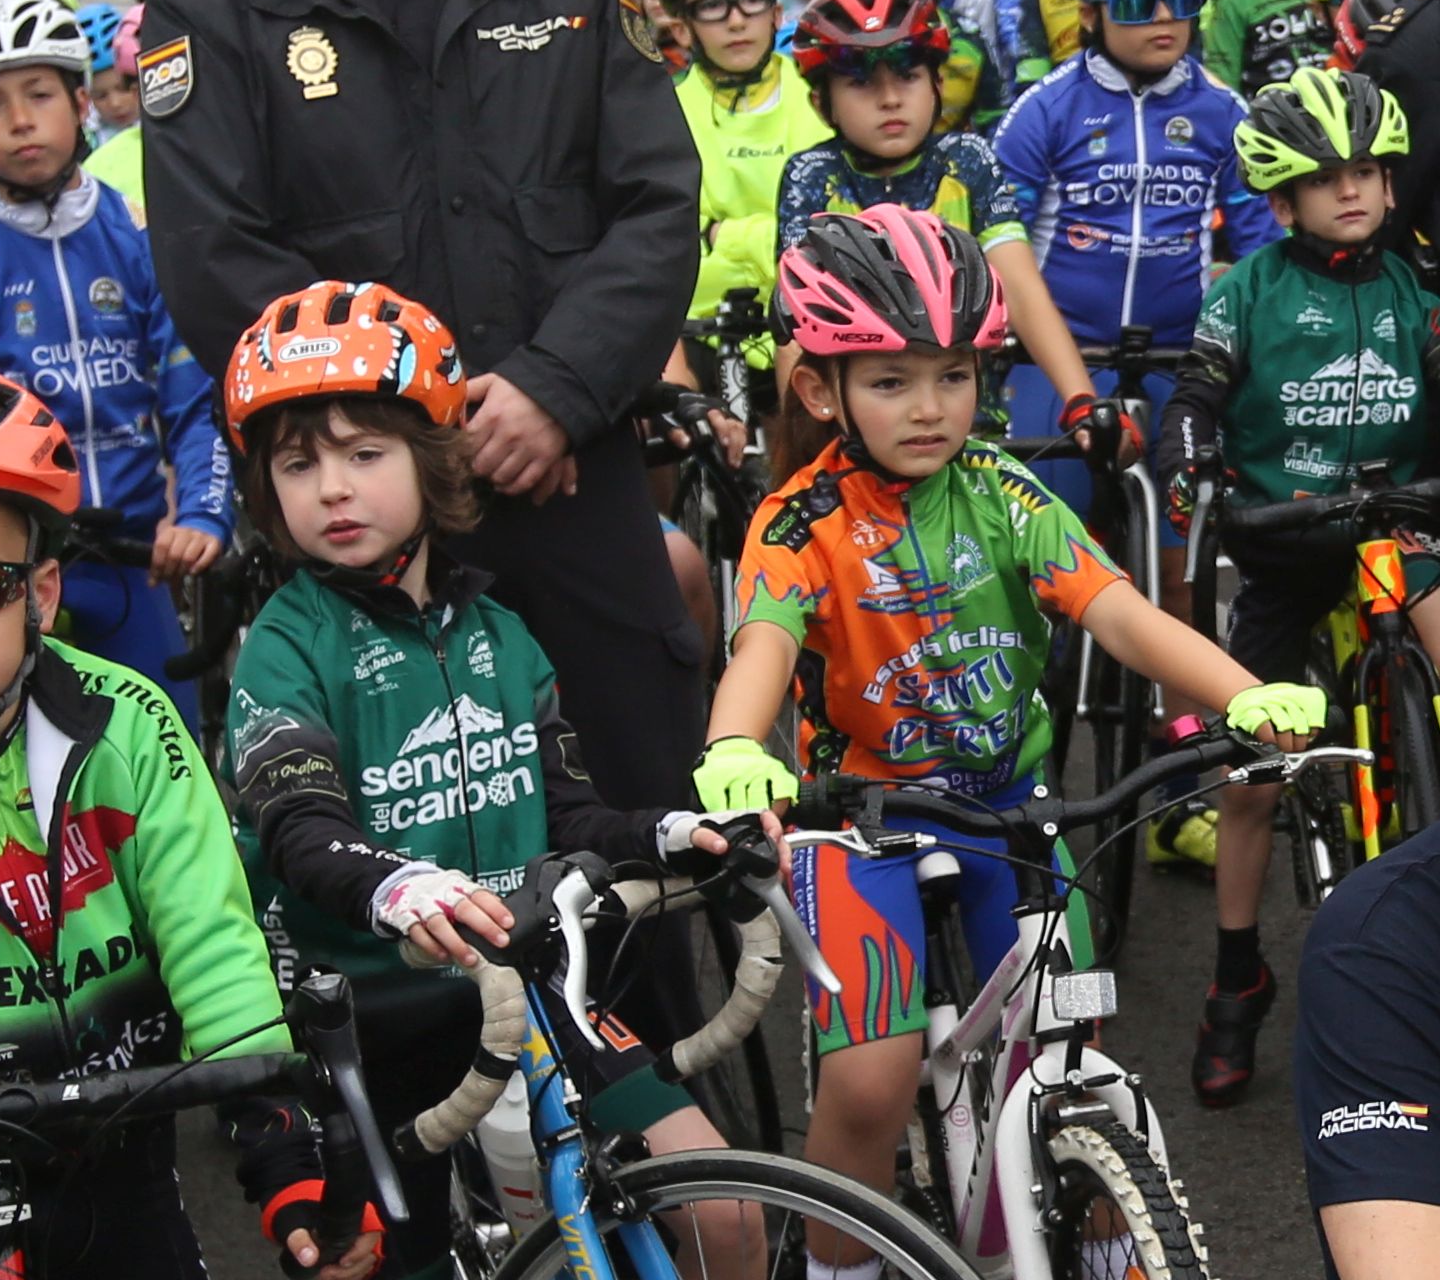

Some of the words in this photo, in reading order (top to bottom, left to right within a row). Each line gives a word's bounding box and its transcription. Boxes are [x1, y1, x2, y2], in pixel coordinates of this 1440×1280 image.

[499, 35, 552, 53] CNP
[143, 55, 187, 91] 200
[1042, 60, 1079, 87] Auto
[1097, 164, 1178, 182] CIUDAD
[1181, 165, 1205, 181] DE
[1093, 183, 1203, 207] OVIEDO
[832, 330, 884, 344] NESTA
[284, 340, 333, 359] ABUS
[1282, 406, 1298, 427] del
[891, 649, 1015, 710] SANTI
[115, 673, 192, 784] mestas
[370, 803, 391, 833] del
[1320, 1100, 1402, 1122] POLICIA
[1317, 1113, 1429, 1140] NACIONAL
